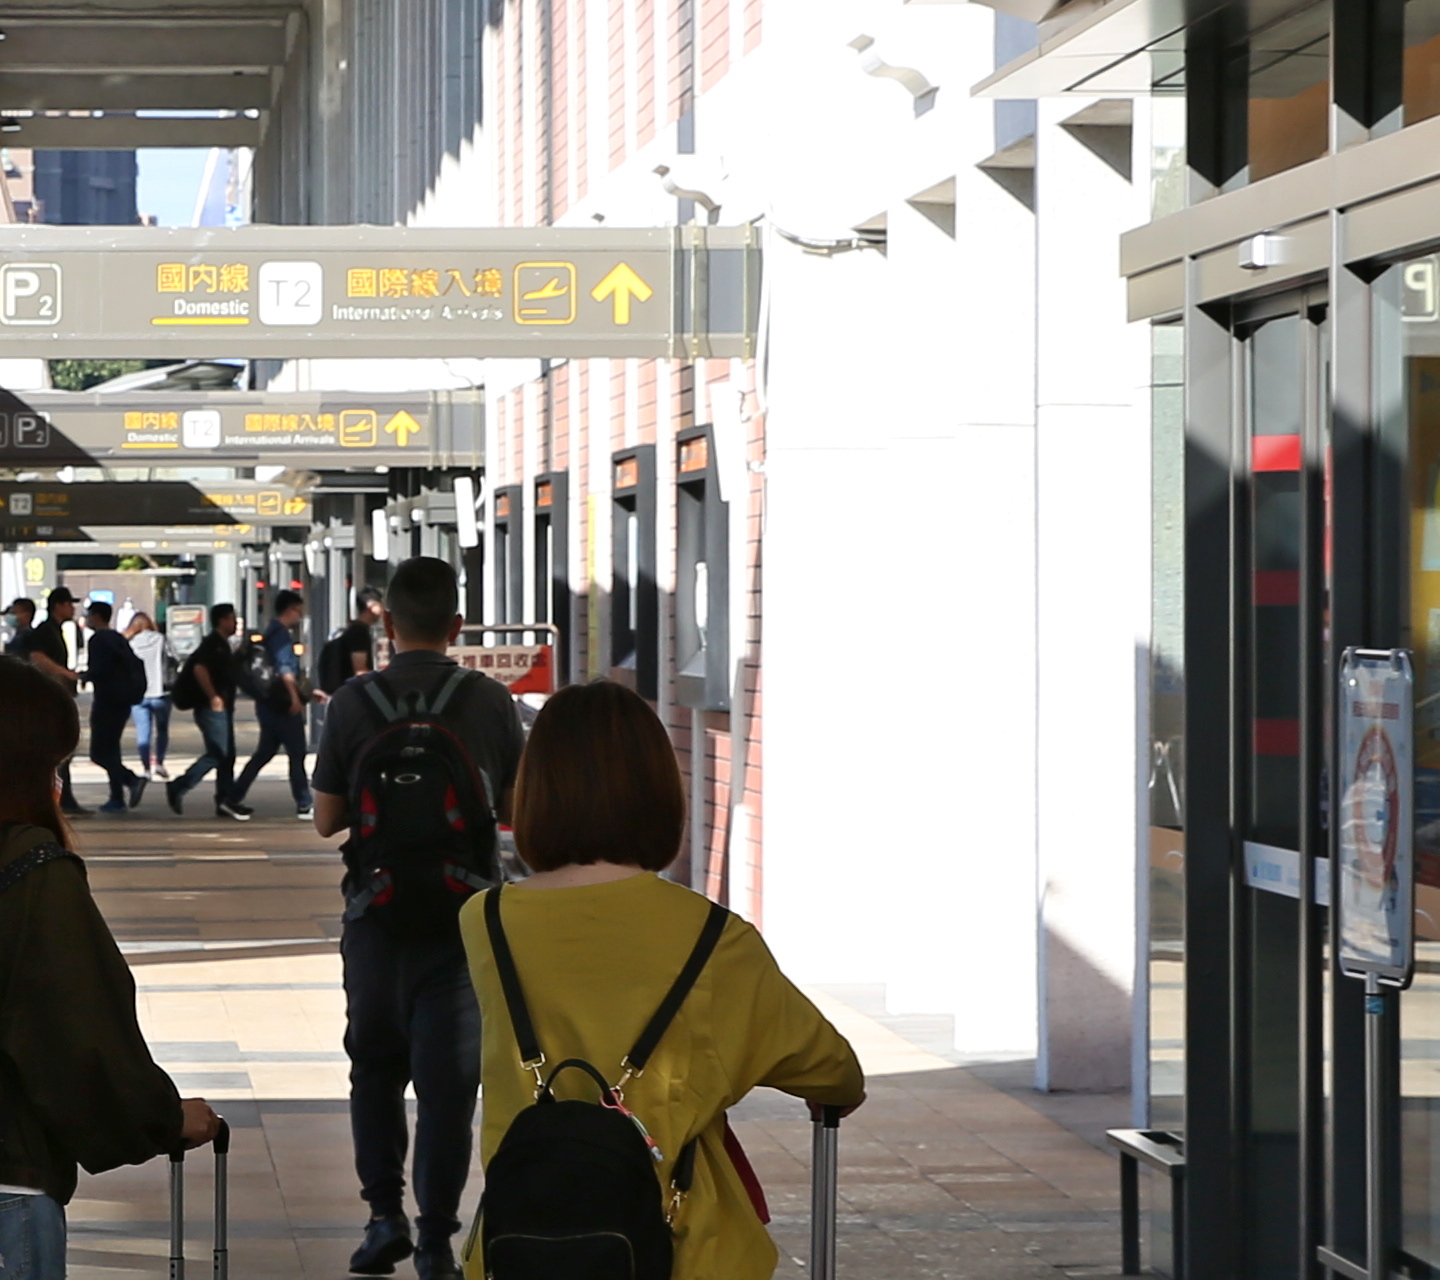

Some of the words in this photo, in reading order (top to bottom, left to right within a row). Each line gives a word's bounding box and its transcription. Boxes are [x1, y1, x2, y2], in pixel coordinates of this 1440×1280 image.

[156, 263, 250, 294] 國內線
[267, 278, 312, 308] T2
[346, 268, 503, 298] 國際線入境
[5, 271, 54, 317] P2
[173, 298, 250, 316] Domestic
[332, 304, 435, 321] International
[188, 419, 214, 436] T2
